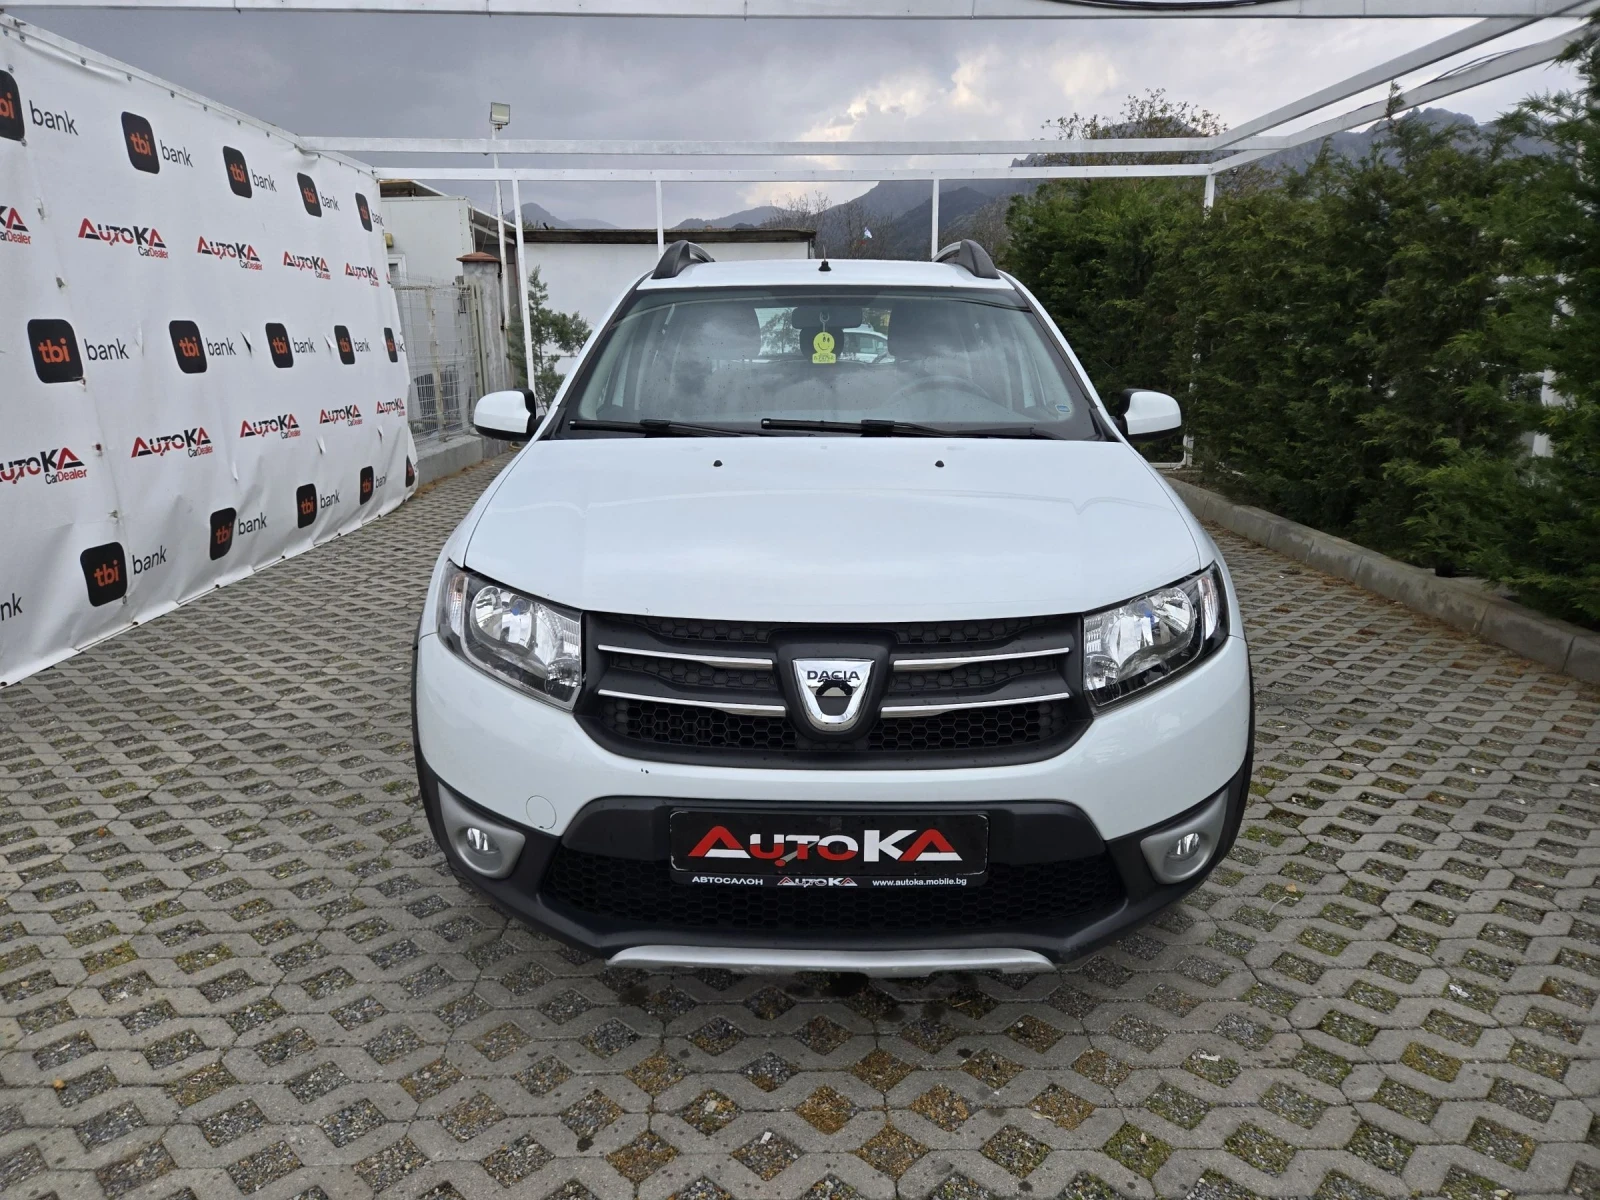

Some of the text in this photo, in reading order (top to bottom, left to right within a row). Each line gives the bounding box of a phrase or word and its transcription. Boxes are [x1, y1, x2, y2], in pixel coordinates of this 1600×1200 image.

[0, 92, 79, 136] bi bank
[130, 132, 194, 168] tbi bank
[230, 163, 278, 193] tbi bank
[304, 188, 340, 212] tbi bank
[370, 210, 385, 226] bank
[37, 336, 130, 364] tbi bank
[178, 335, 238, 358] tbi bank
[272, 336, 317, 355] tbi bank
[339, 337, 372, 353] tbi bank
[0, 446, 86, 484] UTOKA
[45, 468, 88, 485] CarDealer
[300, 489, 341, 515] tbi bank
[215, 511, 268, 545] tbi bank
[93, 544, 167, 588] tbi bank
[0, 593, 24, 622] nk
[806, 670, 861, 681] DACIA
[691, 876, 764, 886] АВТОСАЛОН
[872, 877, 967, 888] www.autoka.mobile.bg
